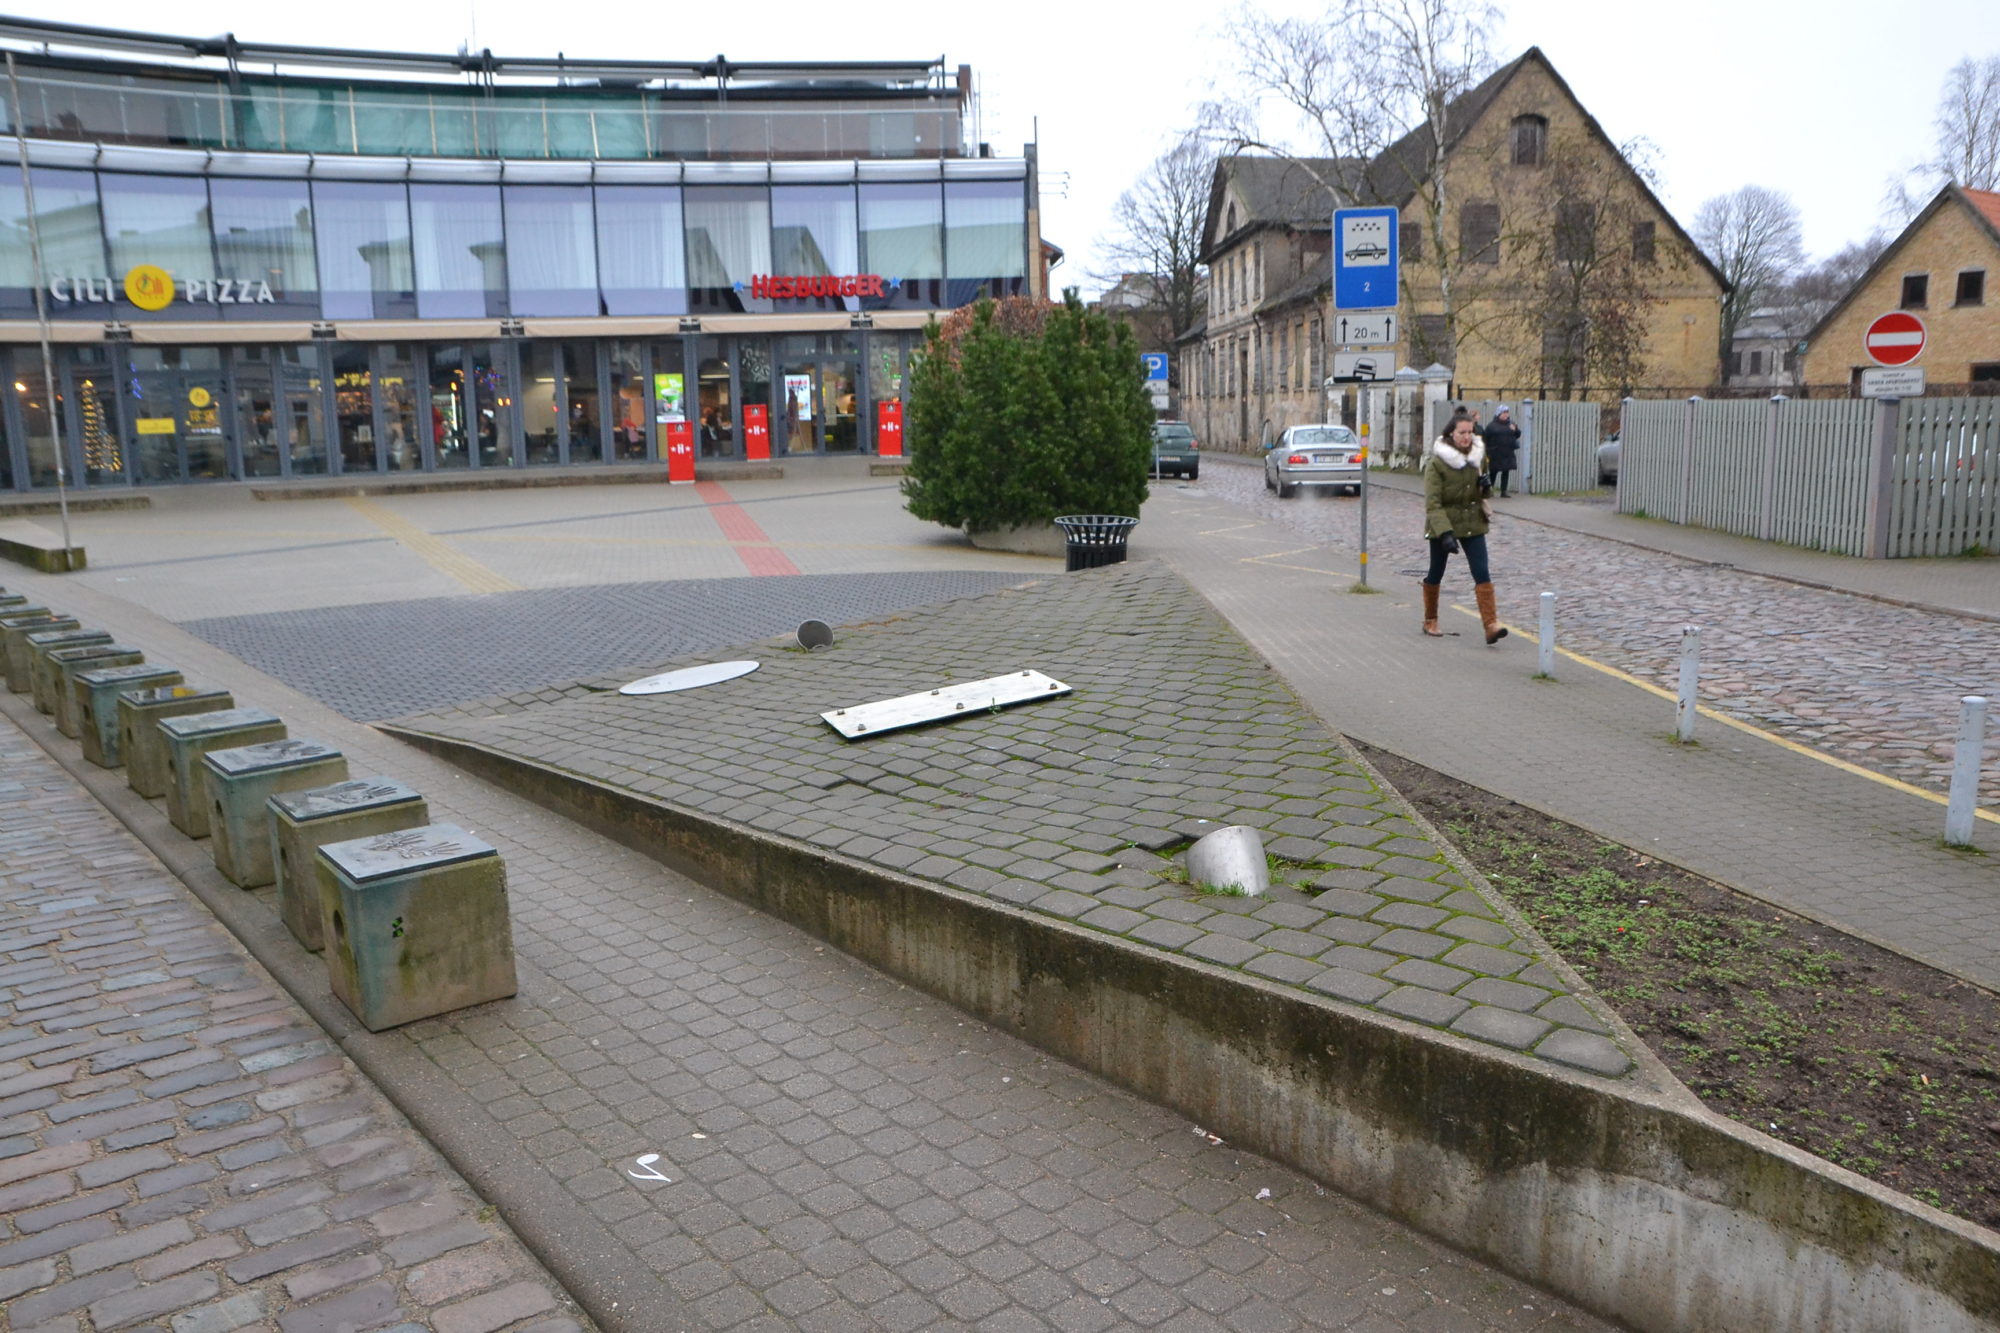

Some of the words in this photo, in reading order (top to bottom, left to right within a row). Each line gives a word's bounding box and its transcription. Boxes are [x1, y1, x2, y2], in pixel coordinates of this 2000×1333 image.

[185, 278, 275, 303] PIZZA
[751, 274, 885, 299] HESBURGER
[1363, 281, 1370, 292] 2
[1354, 327, 1368, 339] 20
[1370, 331, 1379, 339] m
[1146, 356, 1162, 377] P
[753, 424, 760, 435] H
[887, 421, 894, 432] H
[677, 443, 684, 455] H
